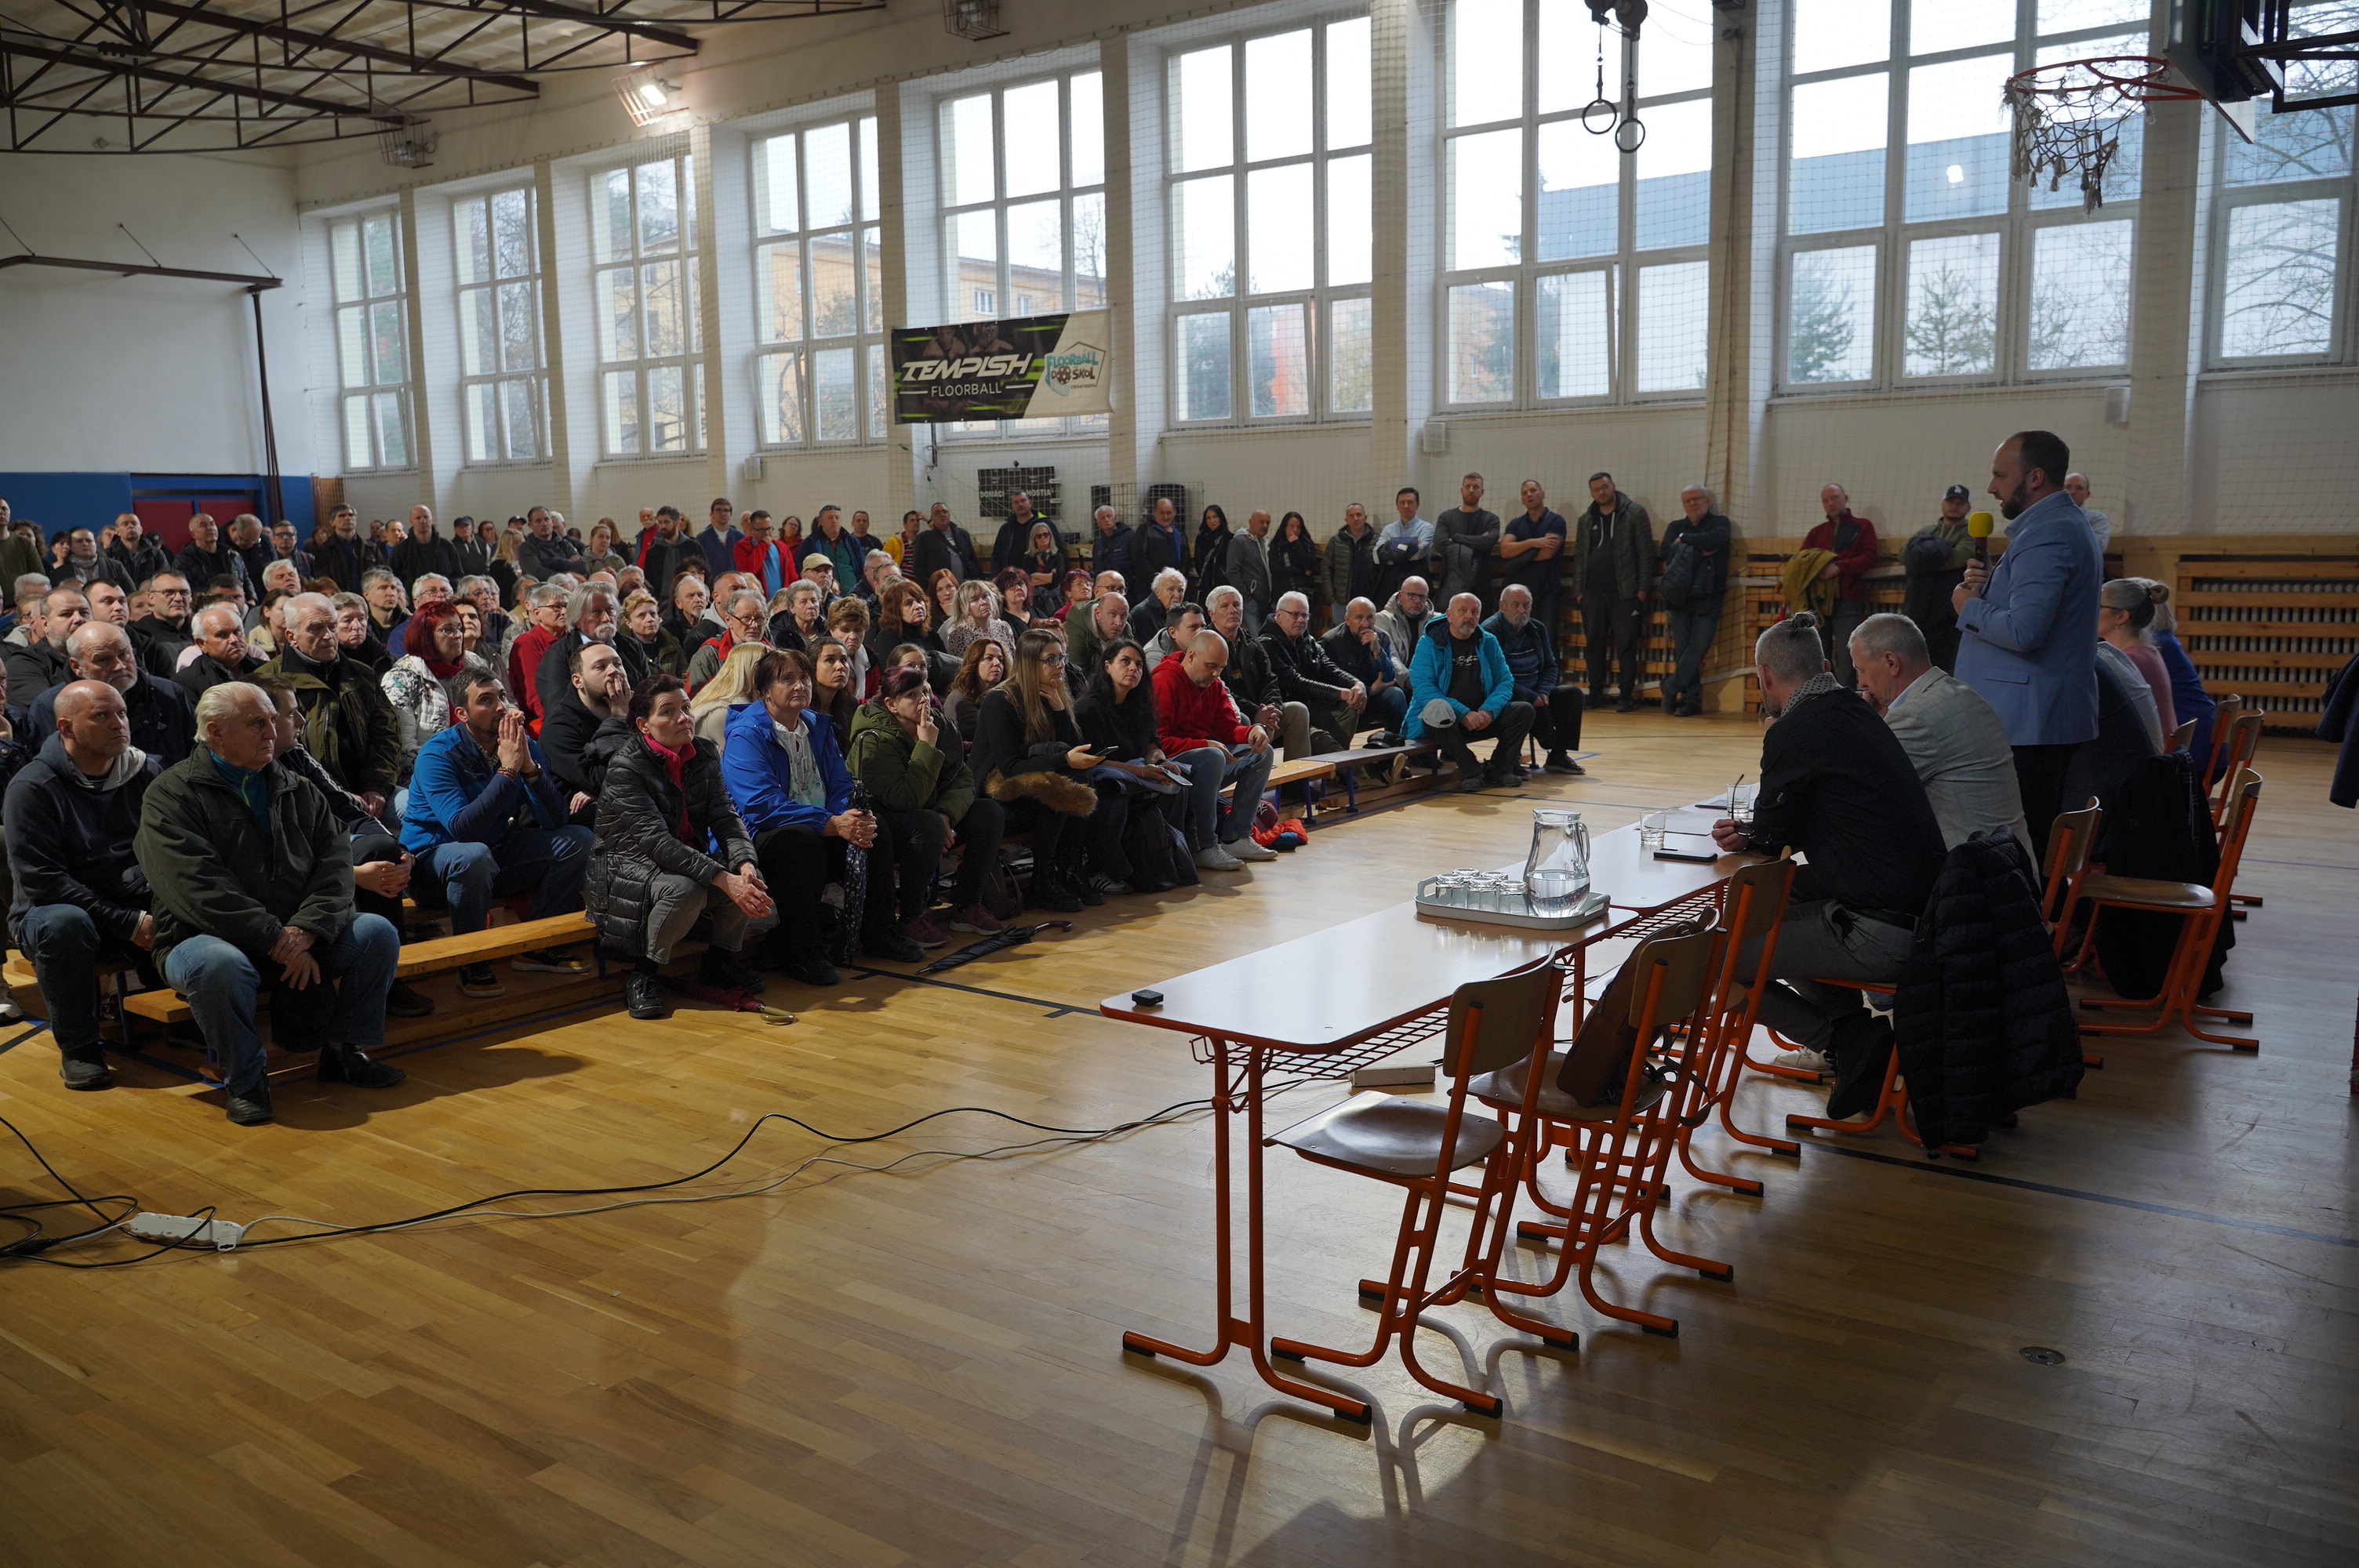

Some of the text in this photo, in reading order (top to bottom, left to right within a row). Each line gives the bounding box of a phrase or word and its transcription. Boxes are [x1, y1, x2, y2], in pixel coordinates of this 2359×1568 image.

[1046, 350, 1099, 368] FLOORBALL
[901, 353, 1034, 382] TEMPISH
[1072, 366, 1096, 380] ŠKOL
[931, 382, 1002, 397] FLOORBALL
[1026, 488, 1052, 497] HOSTIA
